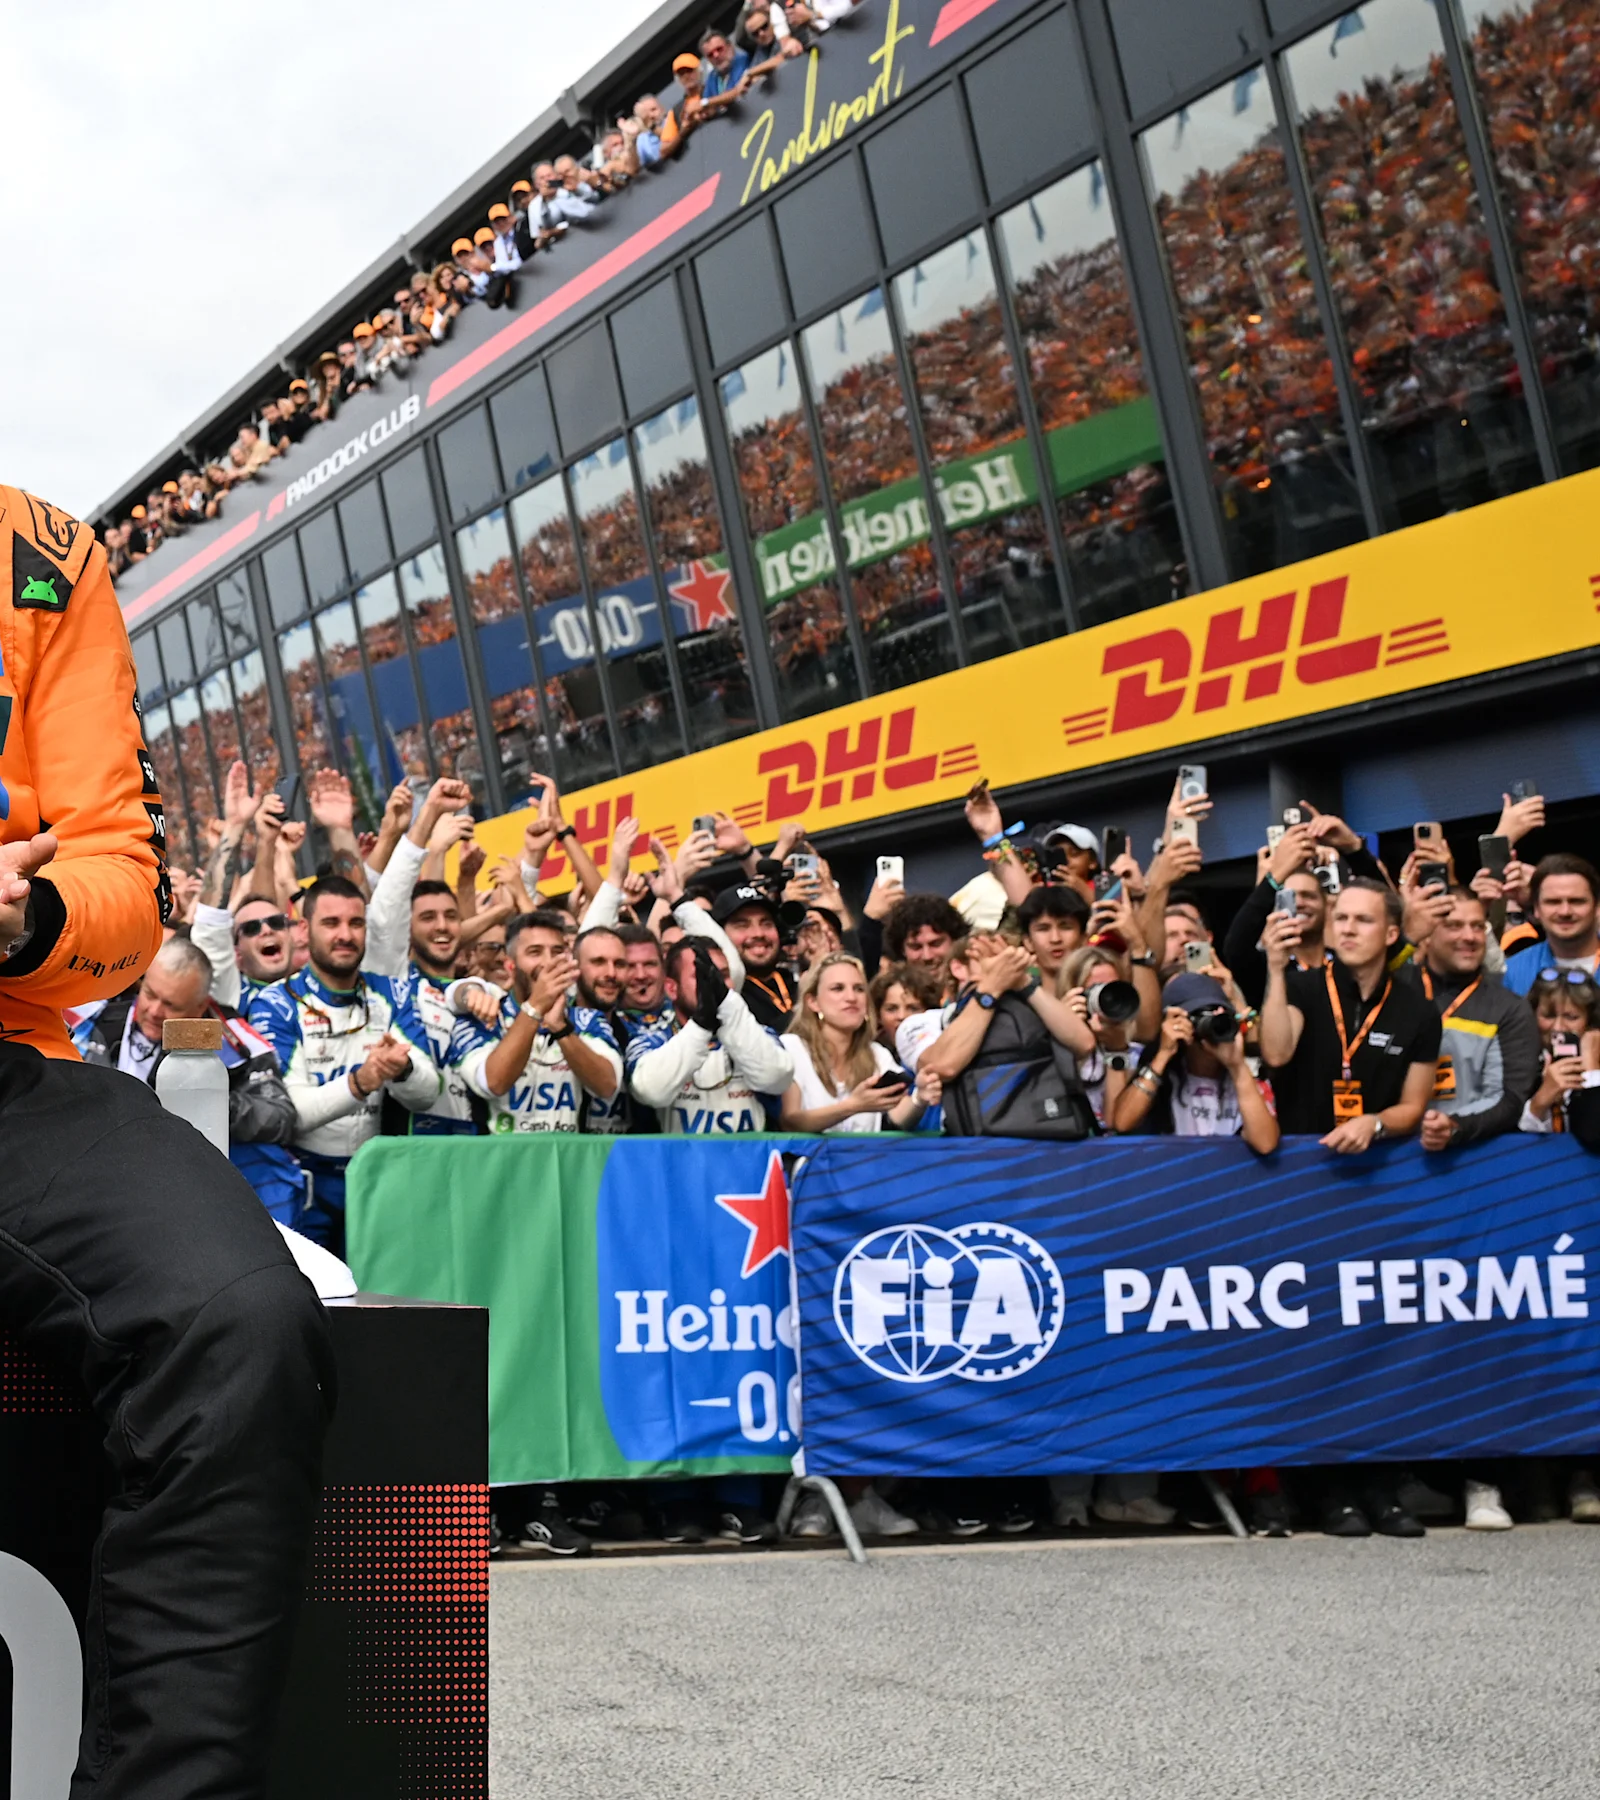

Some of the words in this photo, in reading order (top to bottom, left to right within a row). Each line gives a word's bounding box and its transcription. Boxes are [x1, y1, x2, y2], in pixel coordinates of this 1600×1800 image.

[286, 430, 368, 508] PADDOCK
[369, 394, 420, 447] CLUB
[1101, 575, 1383, 735] DHL
[757, 706, 939, 823] DHL
[508, 1082, 576, 1112] VISA
[520, 1120, 551, 1133] Cash
[675, 1107, 755, 1134] VISA
[1103, 1260, 1309, 1335] PARC
[1338, 1233, 1589, 1326] FERMÉ
